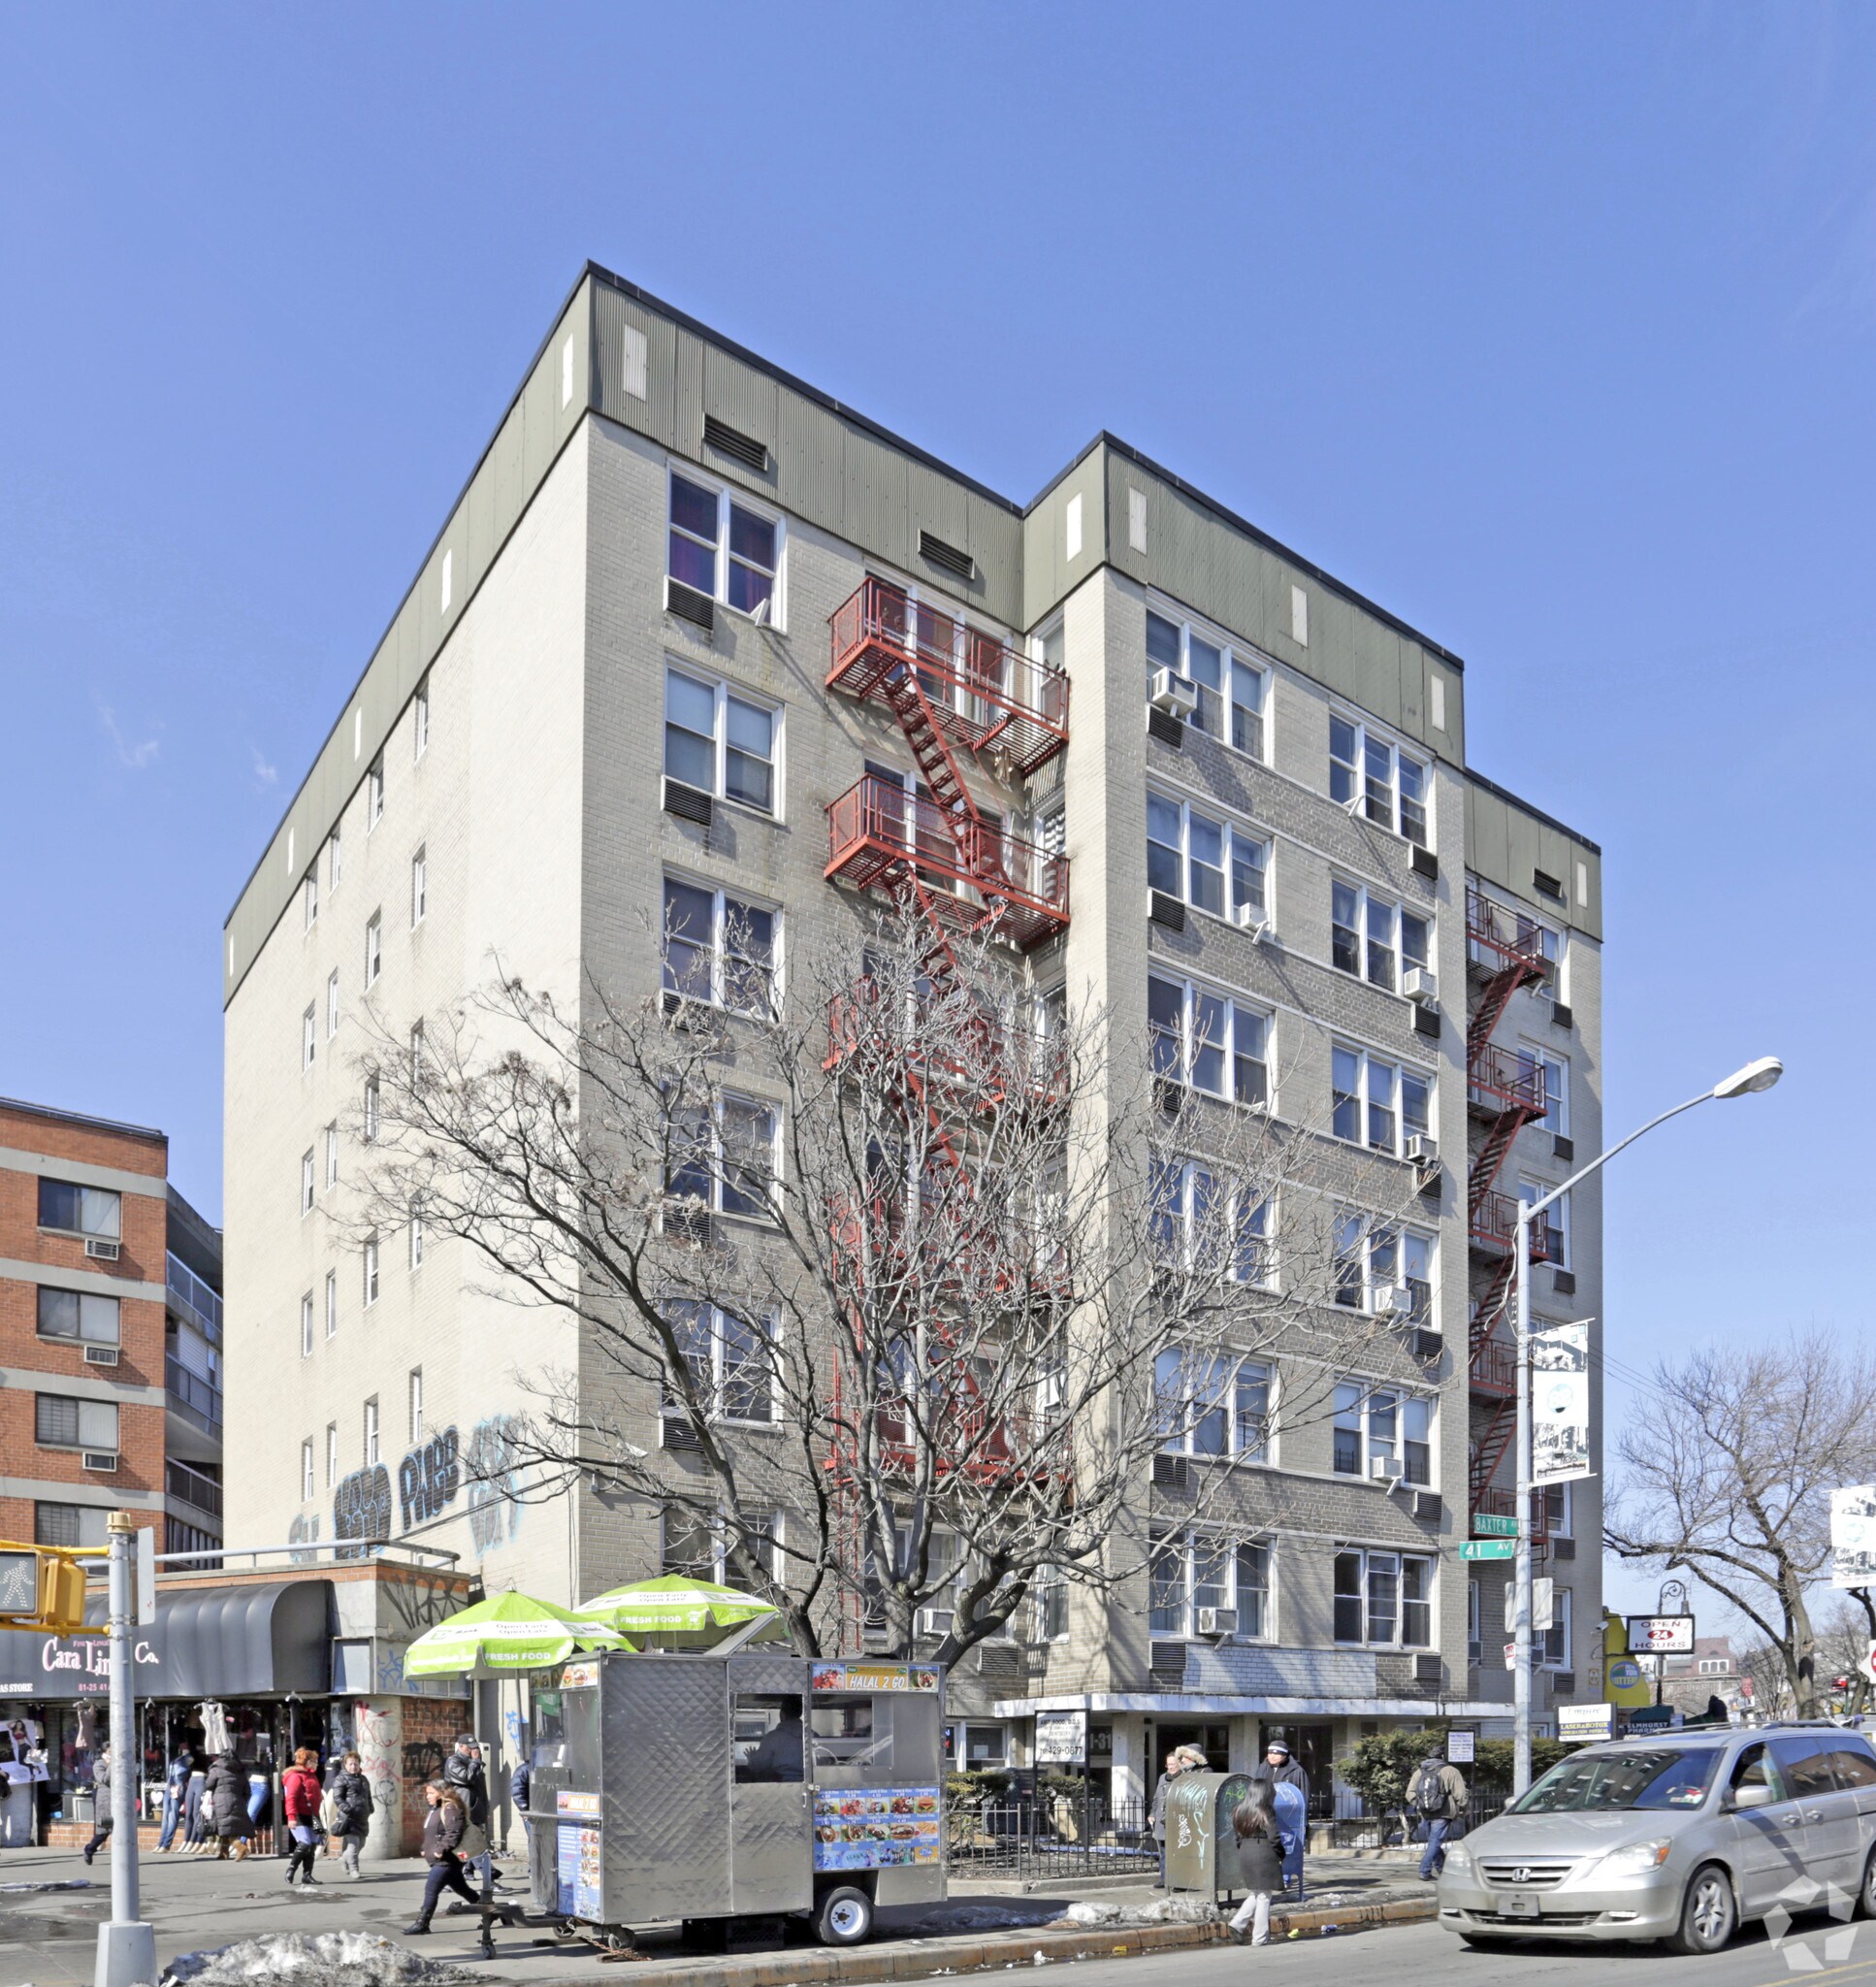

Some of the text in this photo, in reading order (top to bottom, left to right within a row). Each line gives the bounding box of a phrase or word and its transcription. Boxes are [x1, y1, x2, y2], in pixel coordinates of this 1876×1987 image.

[1475, 1515, 1507, 1534] BAXTER
[1465, 1543, 1510, 1558] 41 AV
[621, 1614, 683, 1624] FRESH FOOD
[1640, 1620, 1681, 1629] OPEN
[1653, 1630, 1669, 1640] 24
[1634, 1641, 1687, 1649] HOURS
[42, 1637, 81, 1673] Cara
[135, 1642, 159, 1665] Co.
[485, 1651, 552, 1661] FRESH FOOD
[9, 1682, 33, 1692] STORE
[850, 1676, 905, 1689] HALAL 2 GO
[1049, 1745, 1083, 1756] 429-0877
